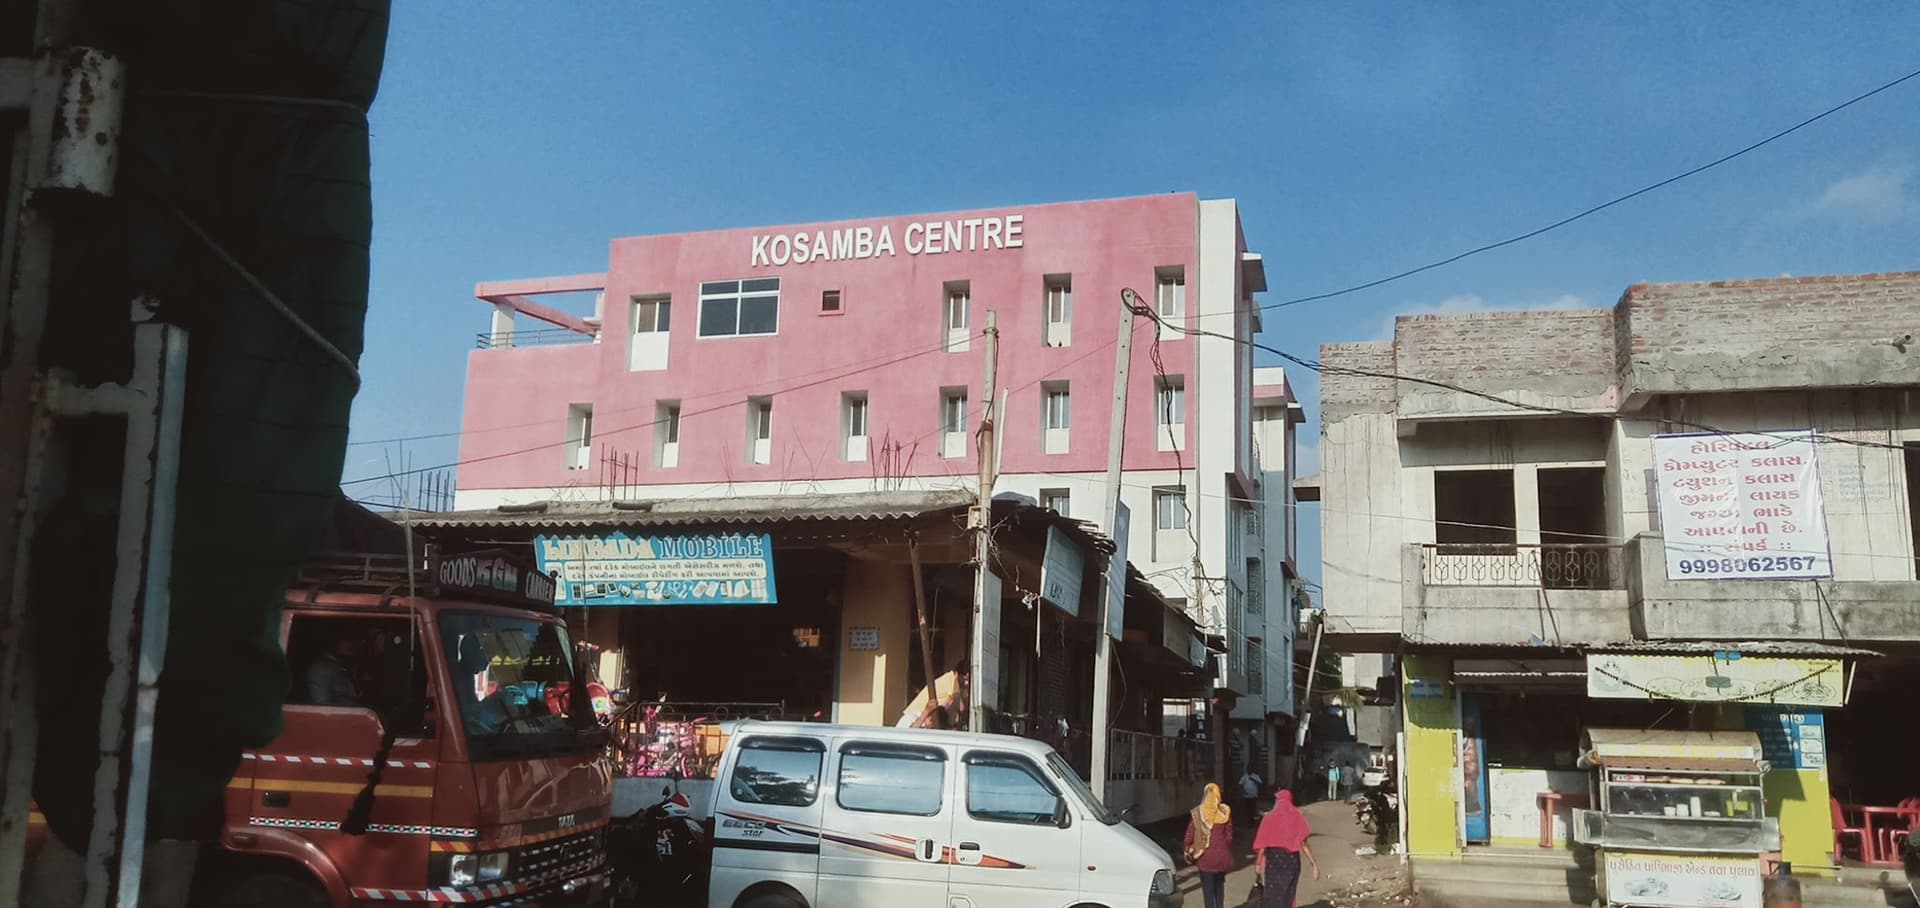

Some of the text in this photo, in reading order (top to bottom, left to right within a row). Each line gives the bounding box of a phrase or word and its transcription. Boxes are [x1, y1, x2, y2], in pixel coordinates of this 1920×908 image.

[751, 215, 1024, 266] KOSAMBA CENTRE
[1753, 503, 1793, 517] ભાડે
[659, 536, 763, 559] MOBILE
[440, 557, 476, 588] GOODS
[1679, 556, 1816, 574] 9998062567
[558, 813, 576, 828] TATA
